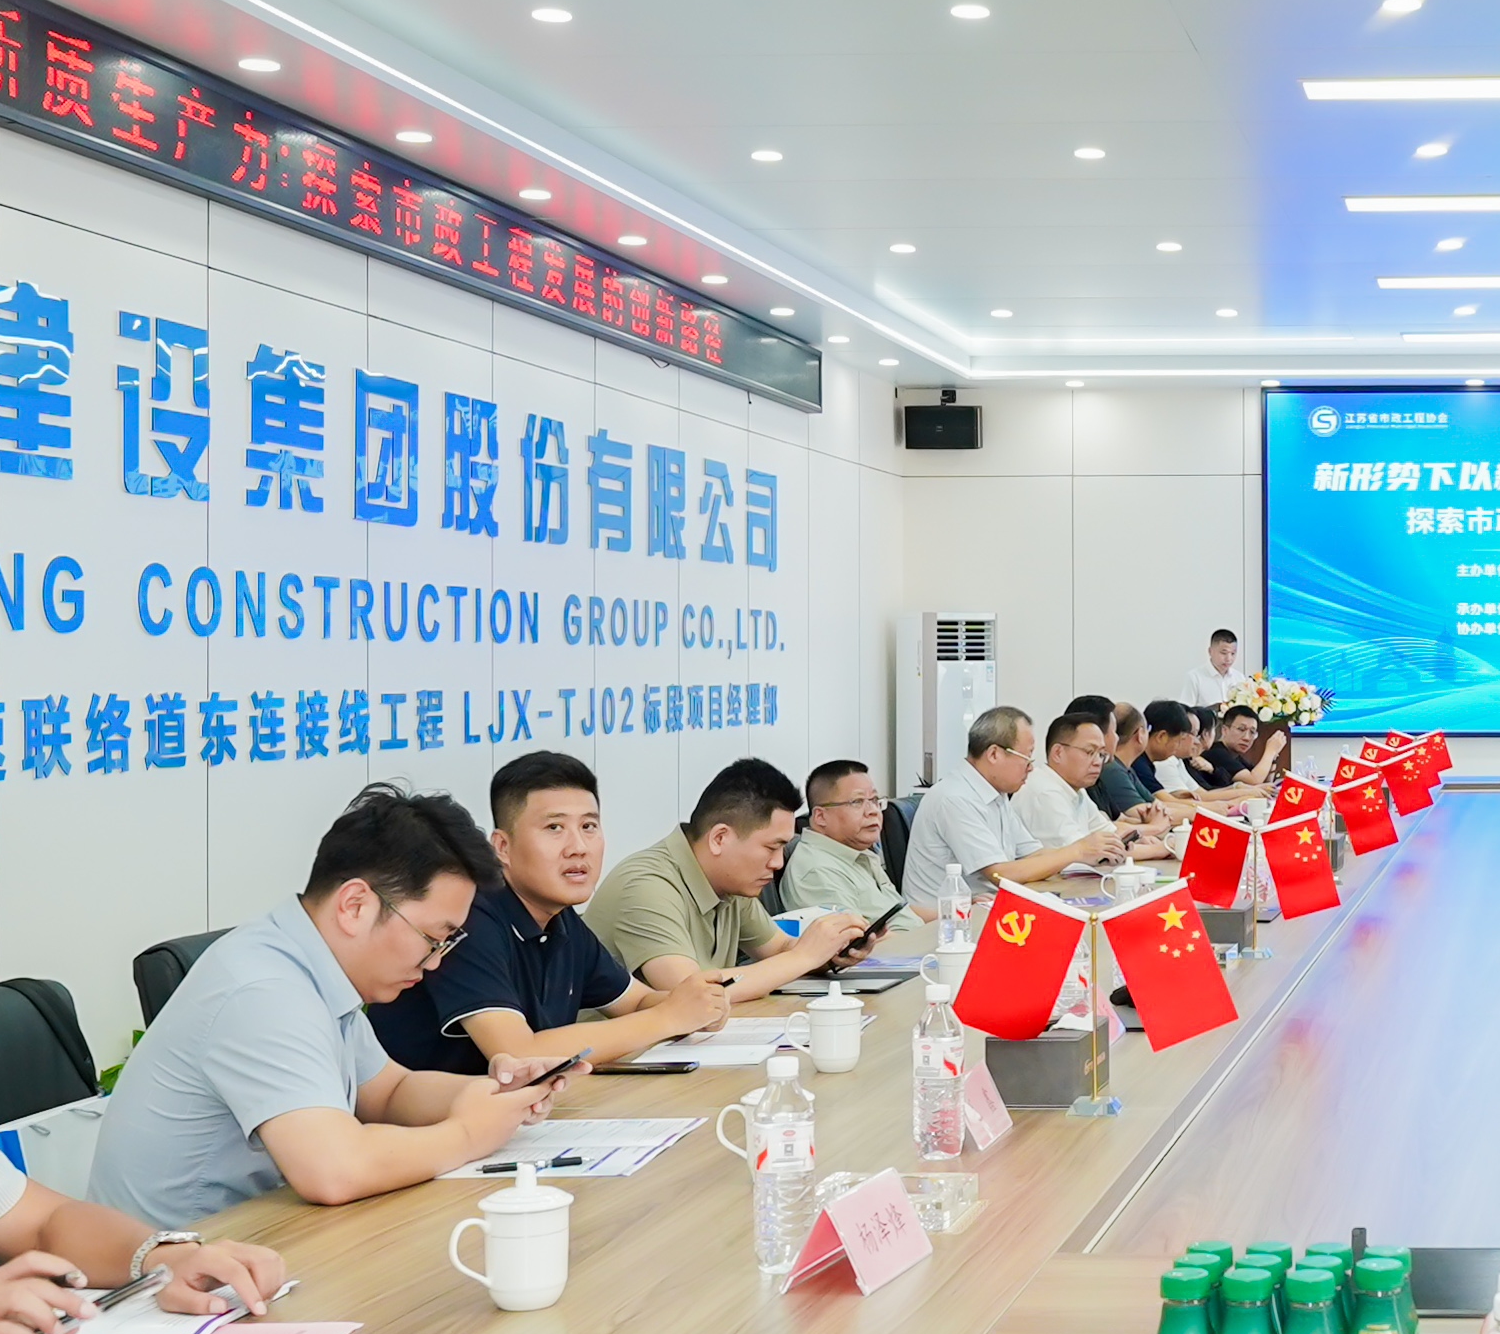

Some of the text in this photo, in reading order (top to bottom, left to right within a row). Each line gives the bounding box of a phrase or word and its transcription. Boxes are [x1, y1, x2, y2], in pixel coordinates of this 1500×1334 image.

[1344, 412, 1449, 424] 江苏省市政工程协会
[137, 562, 540, 646] CONSTRUCTION
[563, 594, 669, 650] GROUP
[680, 604, 786, 660] CO.,LTD.
